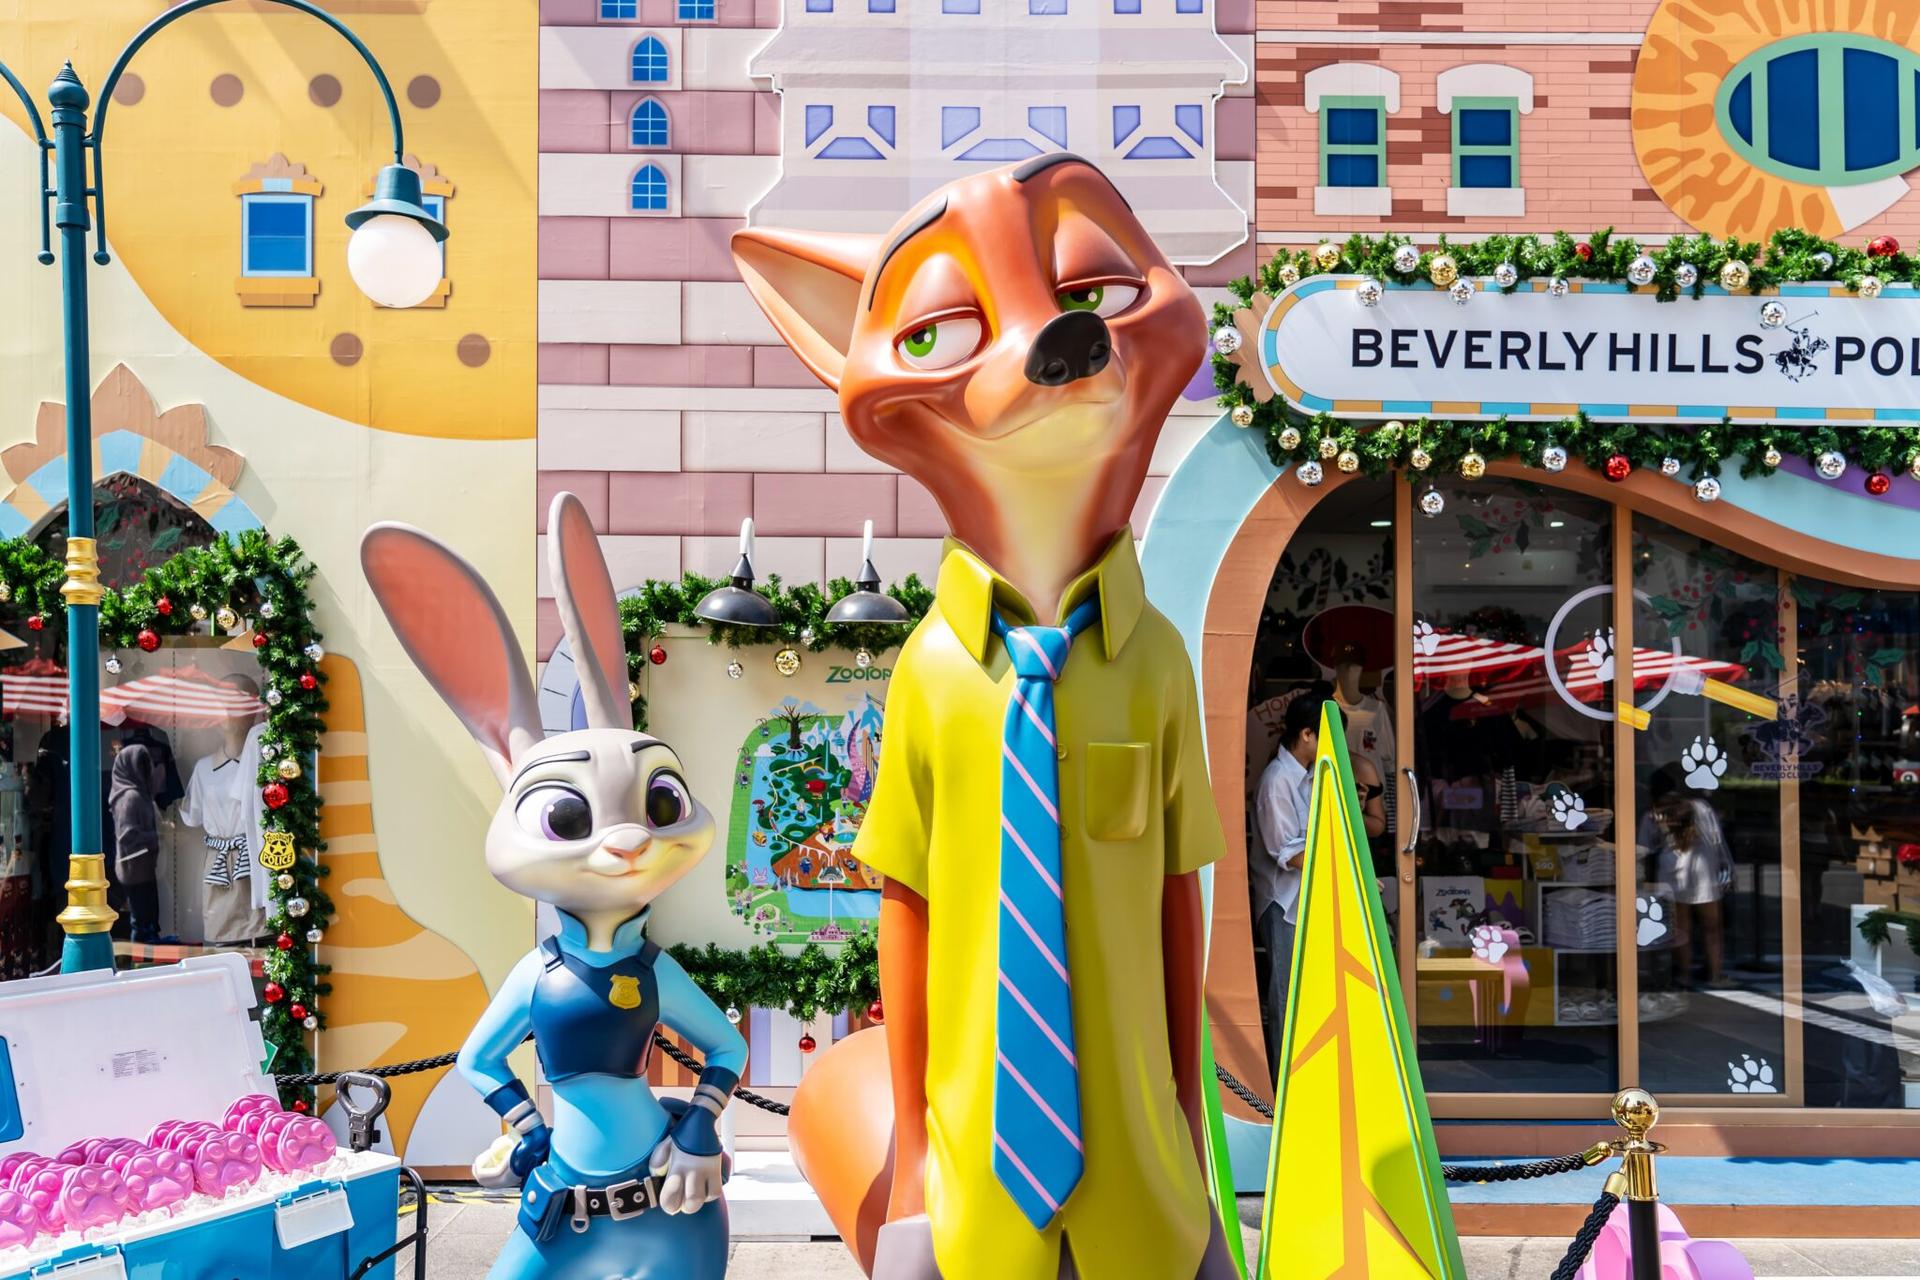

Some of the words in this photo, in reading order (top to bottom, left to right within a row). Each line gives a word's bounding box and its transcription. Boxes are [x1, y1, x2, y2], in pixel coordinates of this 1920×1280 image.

[1352, 328, 1598, 370] BEVERLY
[1608, 332, 1764, 374] HILLS
[262, 851, 293, 866] POLICE
